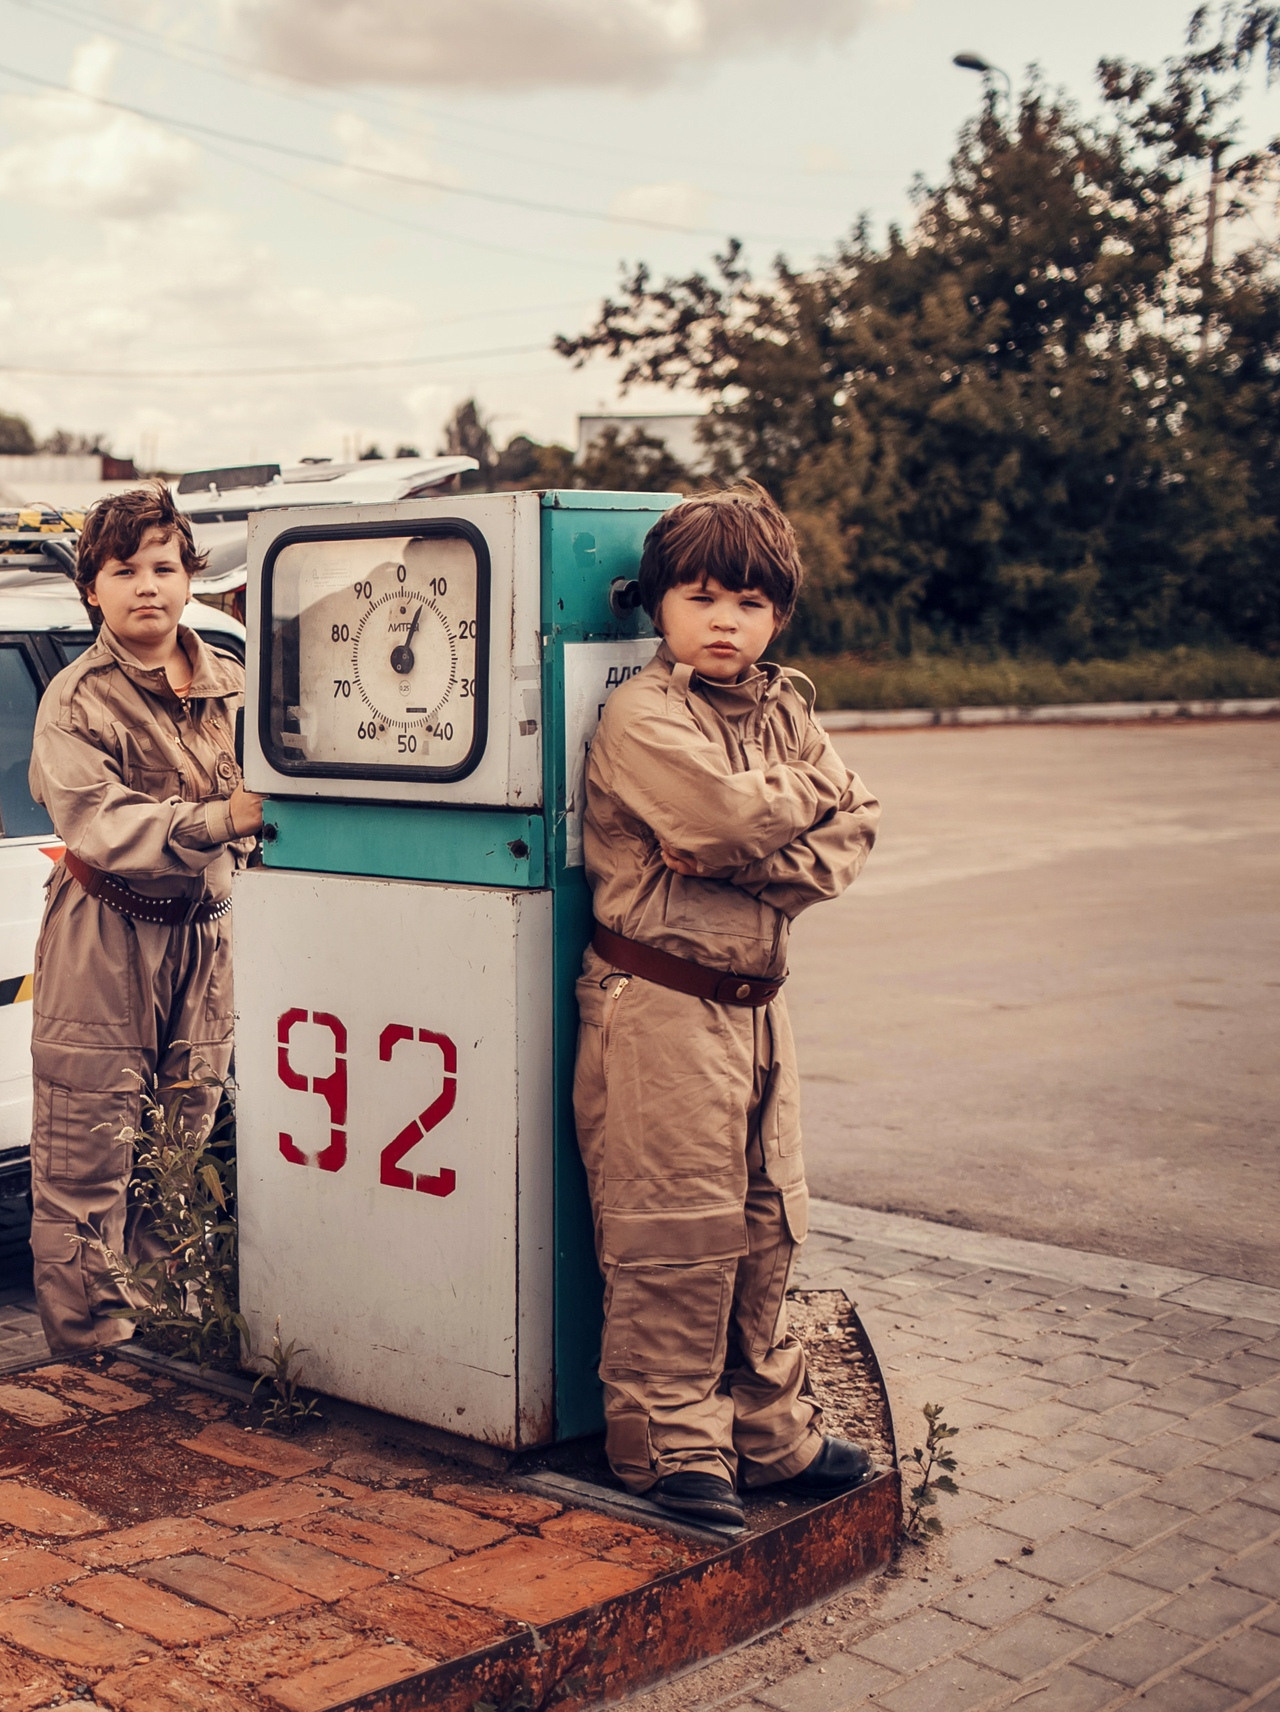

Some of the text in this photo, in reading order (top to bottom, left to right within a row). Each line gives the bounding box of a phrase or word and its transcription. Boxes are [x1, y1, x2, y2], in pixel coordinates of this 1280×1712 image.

[397, 565, 406, 583] 0
[354, 581, 372, 600] 90
[429, 577, 447, 596] 10
[331, 624, 349, 643] 80
[459, 620, 477, 639] 20
[333, 680, 351, 698] 70
[357, 721, 377, 740] 60
[433, 722, 453, 741] 40
[398, 735, 417, 753] 50
[277, 1007, 457, 1198] 92
